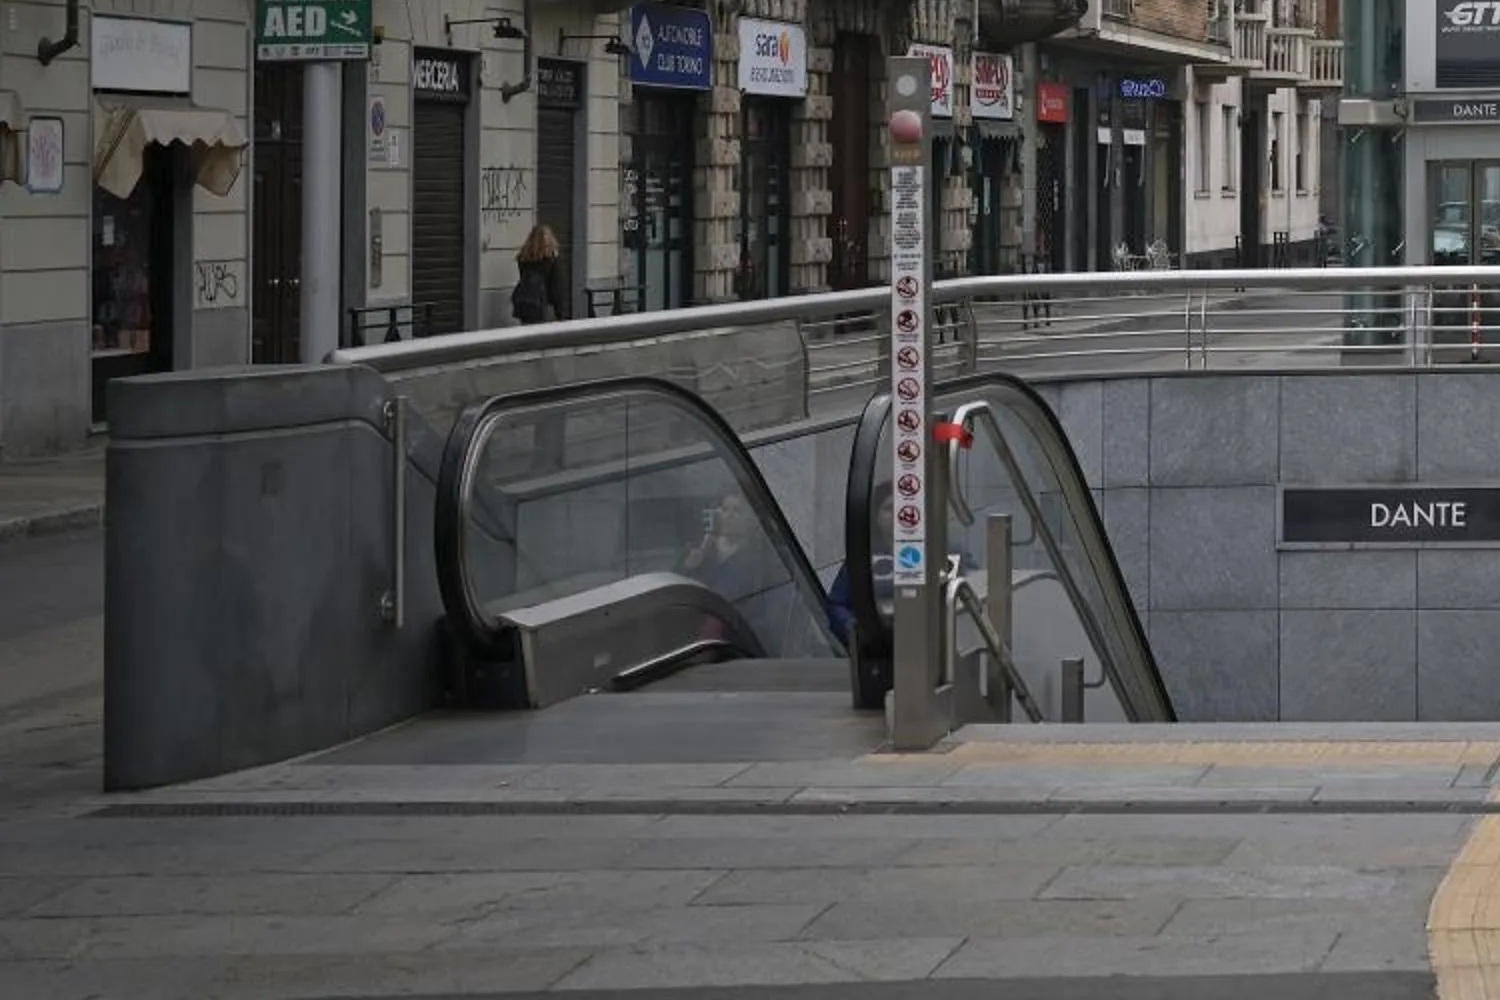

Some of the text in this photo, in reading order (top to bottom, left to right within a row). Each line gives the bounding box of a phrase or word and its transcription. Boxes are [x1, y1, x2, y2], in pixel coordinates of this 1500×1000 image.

[263, 6, 327, 37] AED
[755, 33, 778, 57] sara
[413, 59, 459, 92] MERCERIA
[1453, 104, 1497, 117] DANTE
[1371, 502, 1466, 527] DANTE
